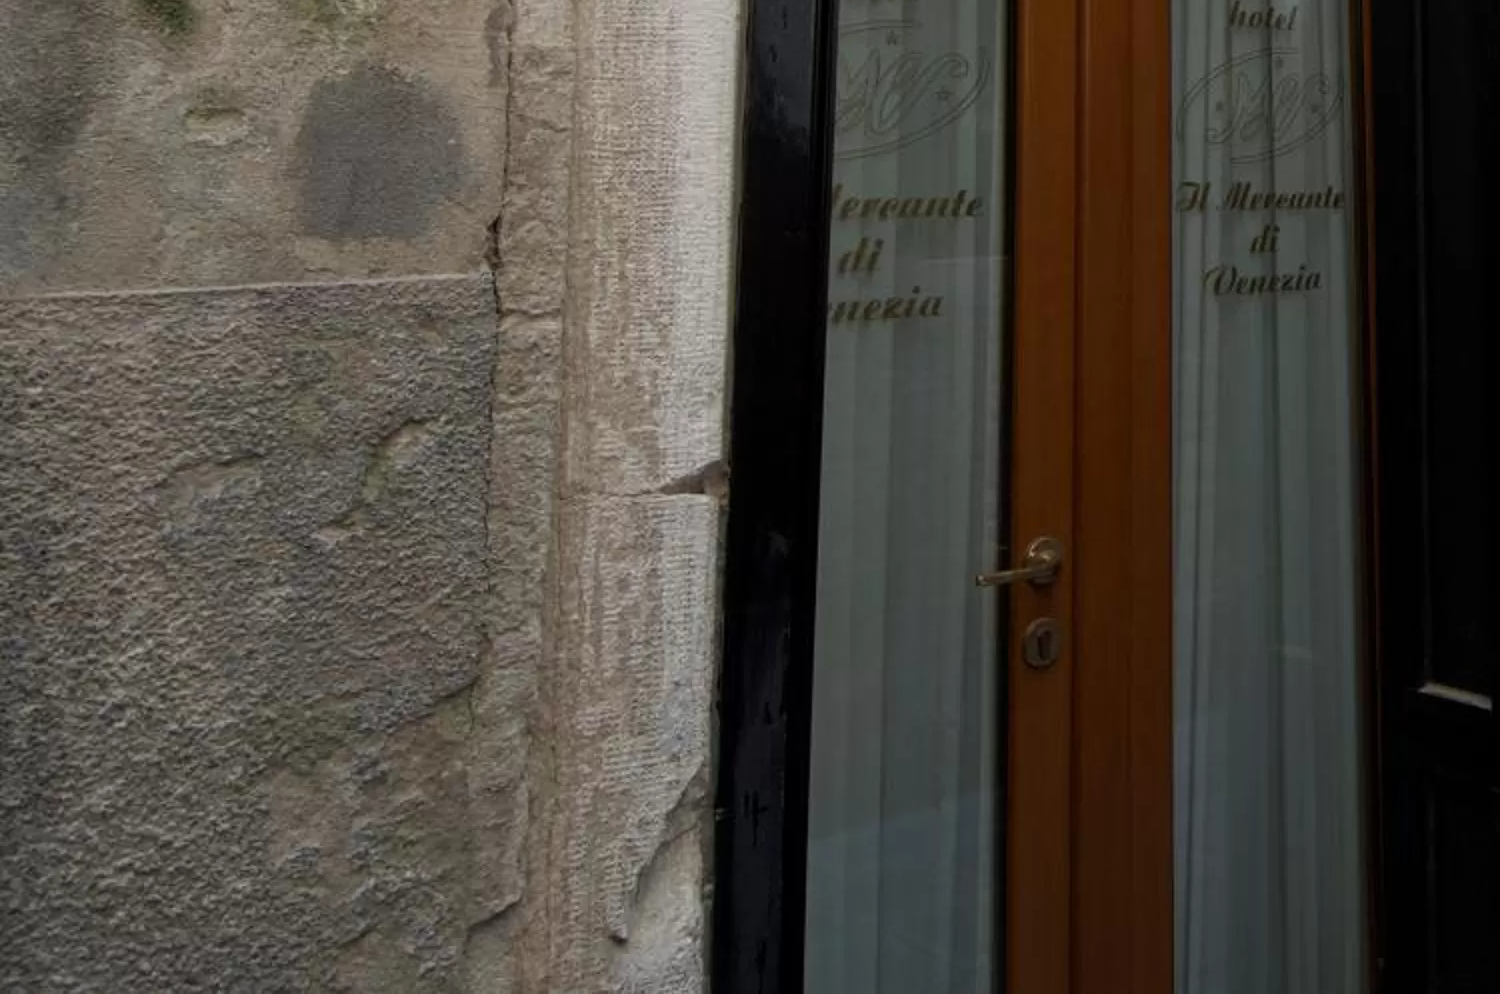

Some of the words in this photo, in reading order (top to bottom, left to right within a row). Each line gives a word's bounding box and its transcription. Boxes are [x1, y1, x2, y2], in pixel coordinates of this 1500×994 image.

[1227, 0, 1298, 32] hotel
[1175, 180, 1210, 213] Il
[1215, 180, 1346, 212] Mercante
[1248, 223, 1281, 255] di
[837, 237, 884, 276] di
[1201, 265, 1323, 298] Venezia
[828, 285, 945, 325] nezia
